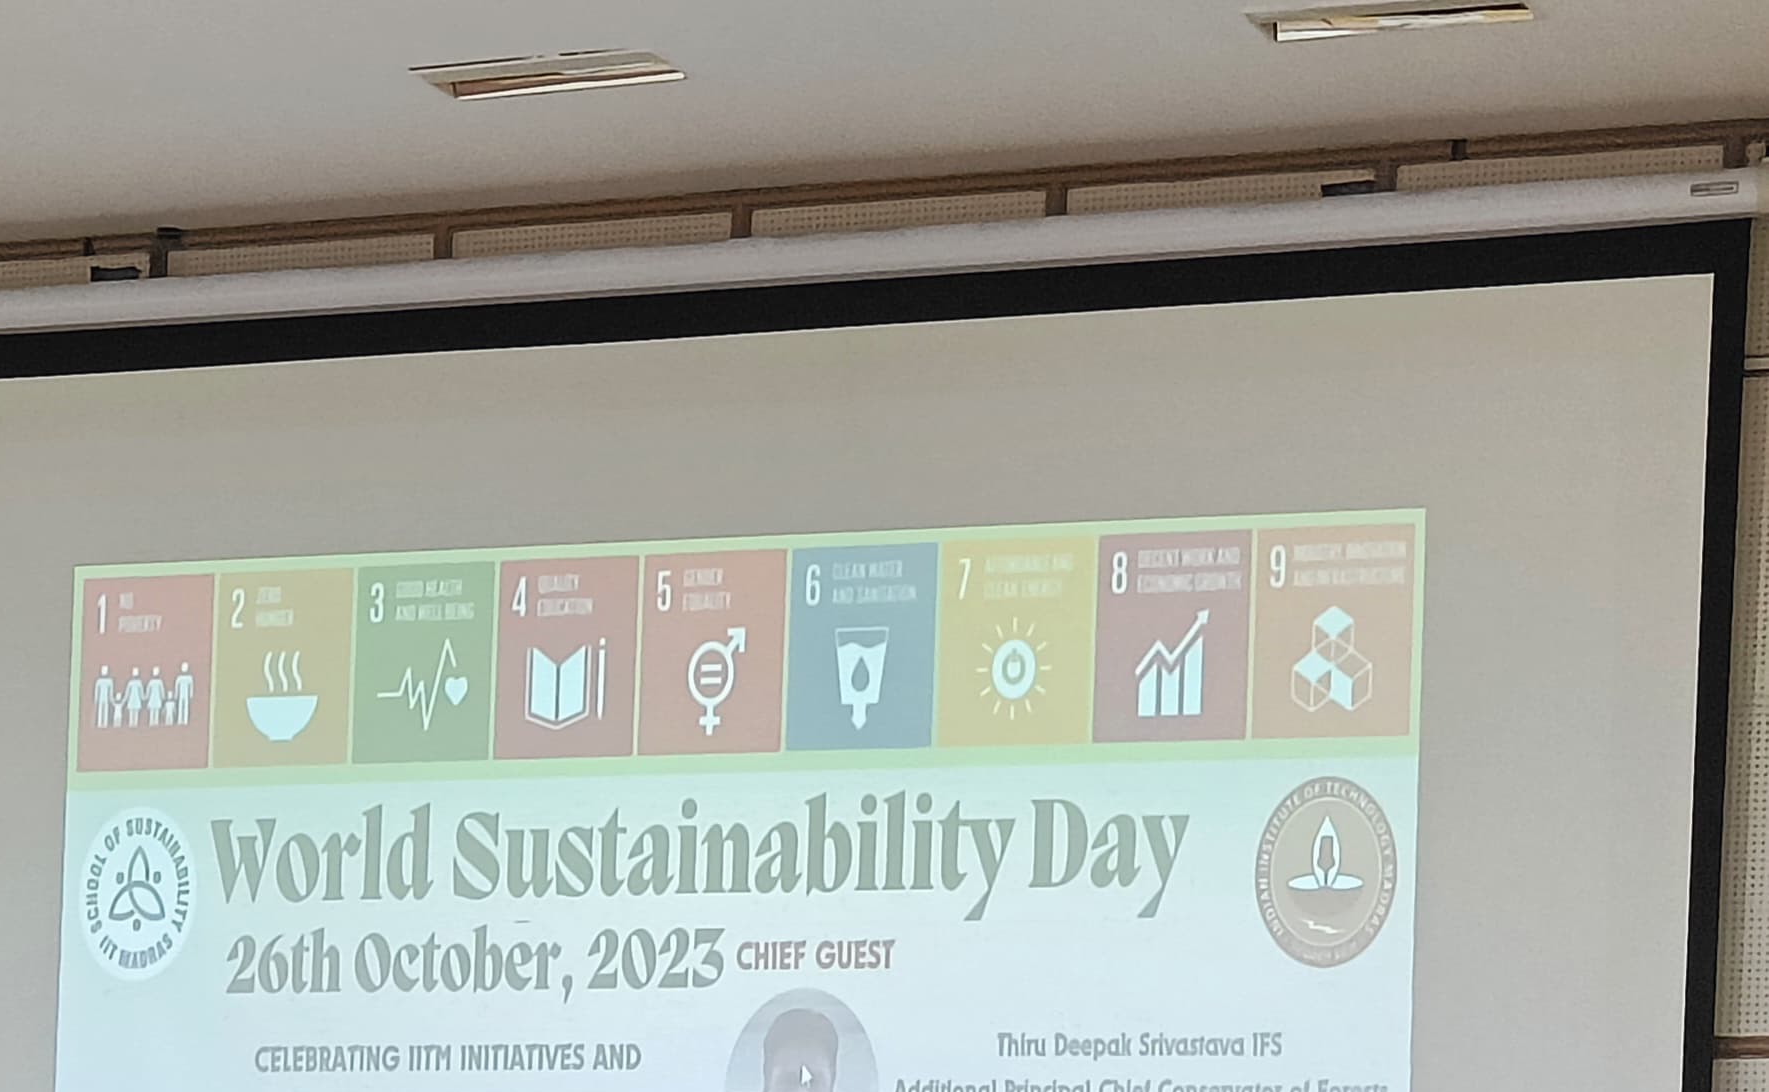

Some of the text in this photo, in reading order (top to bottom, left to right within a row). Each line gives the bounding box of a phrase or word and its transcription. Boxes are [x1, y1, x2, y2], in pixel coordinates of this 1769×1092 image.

[805, 564, 821, 606] 6
[958, 558, 972, 600] 7
[1111, 551, 1127, 594] 8
[1269, 544, 1286, 588] 9
[231, 588, 245, 628] 2
[370, 582, 385, 623] 3
[512, 576, 526, 616] 4
[657, 570, 672, 612] 5
[97, 593, 107, 635] 1
[210, 790, 1190, 921] World Sustainability Day
[225, 923, 726, 1005] 26th October, 2023
[735, 938, 895, 971] CHIEF GUEST
[254, 1043, 642, 1072] CELEBRATING IITM INITIATIVES AND
[997, 1032, 1282, 1061] Thiru Deepak Srivastava IFS
